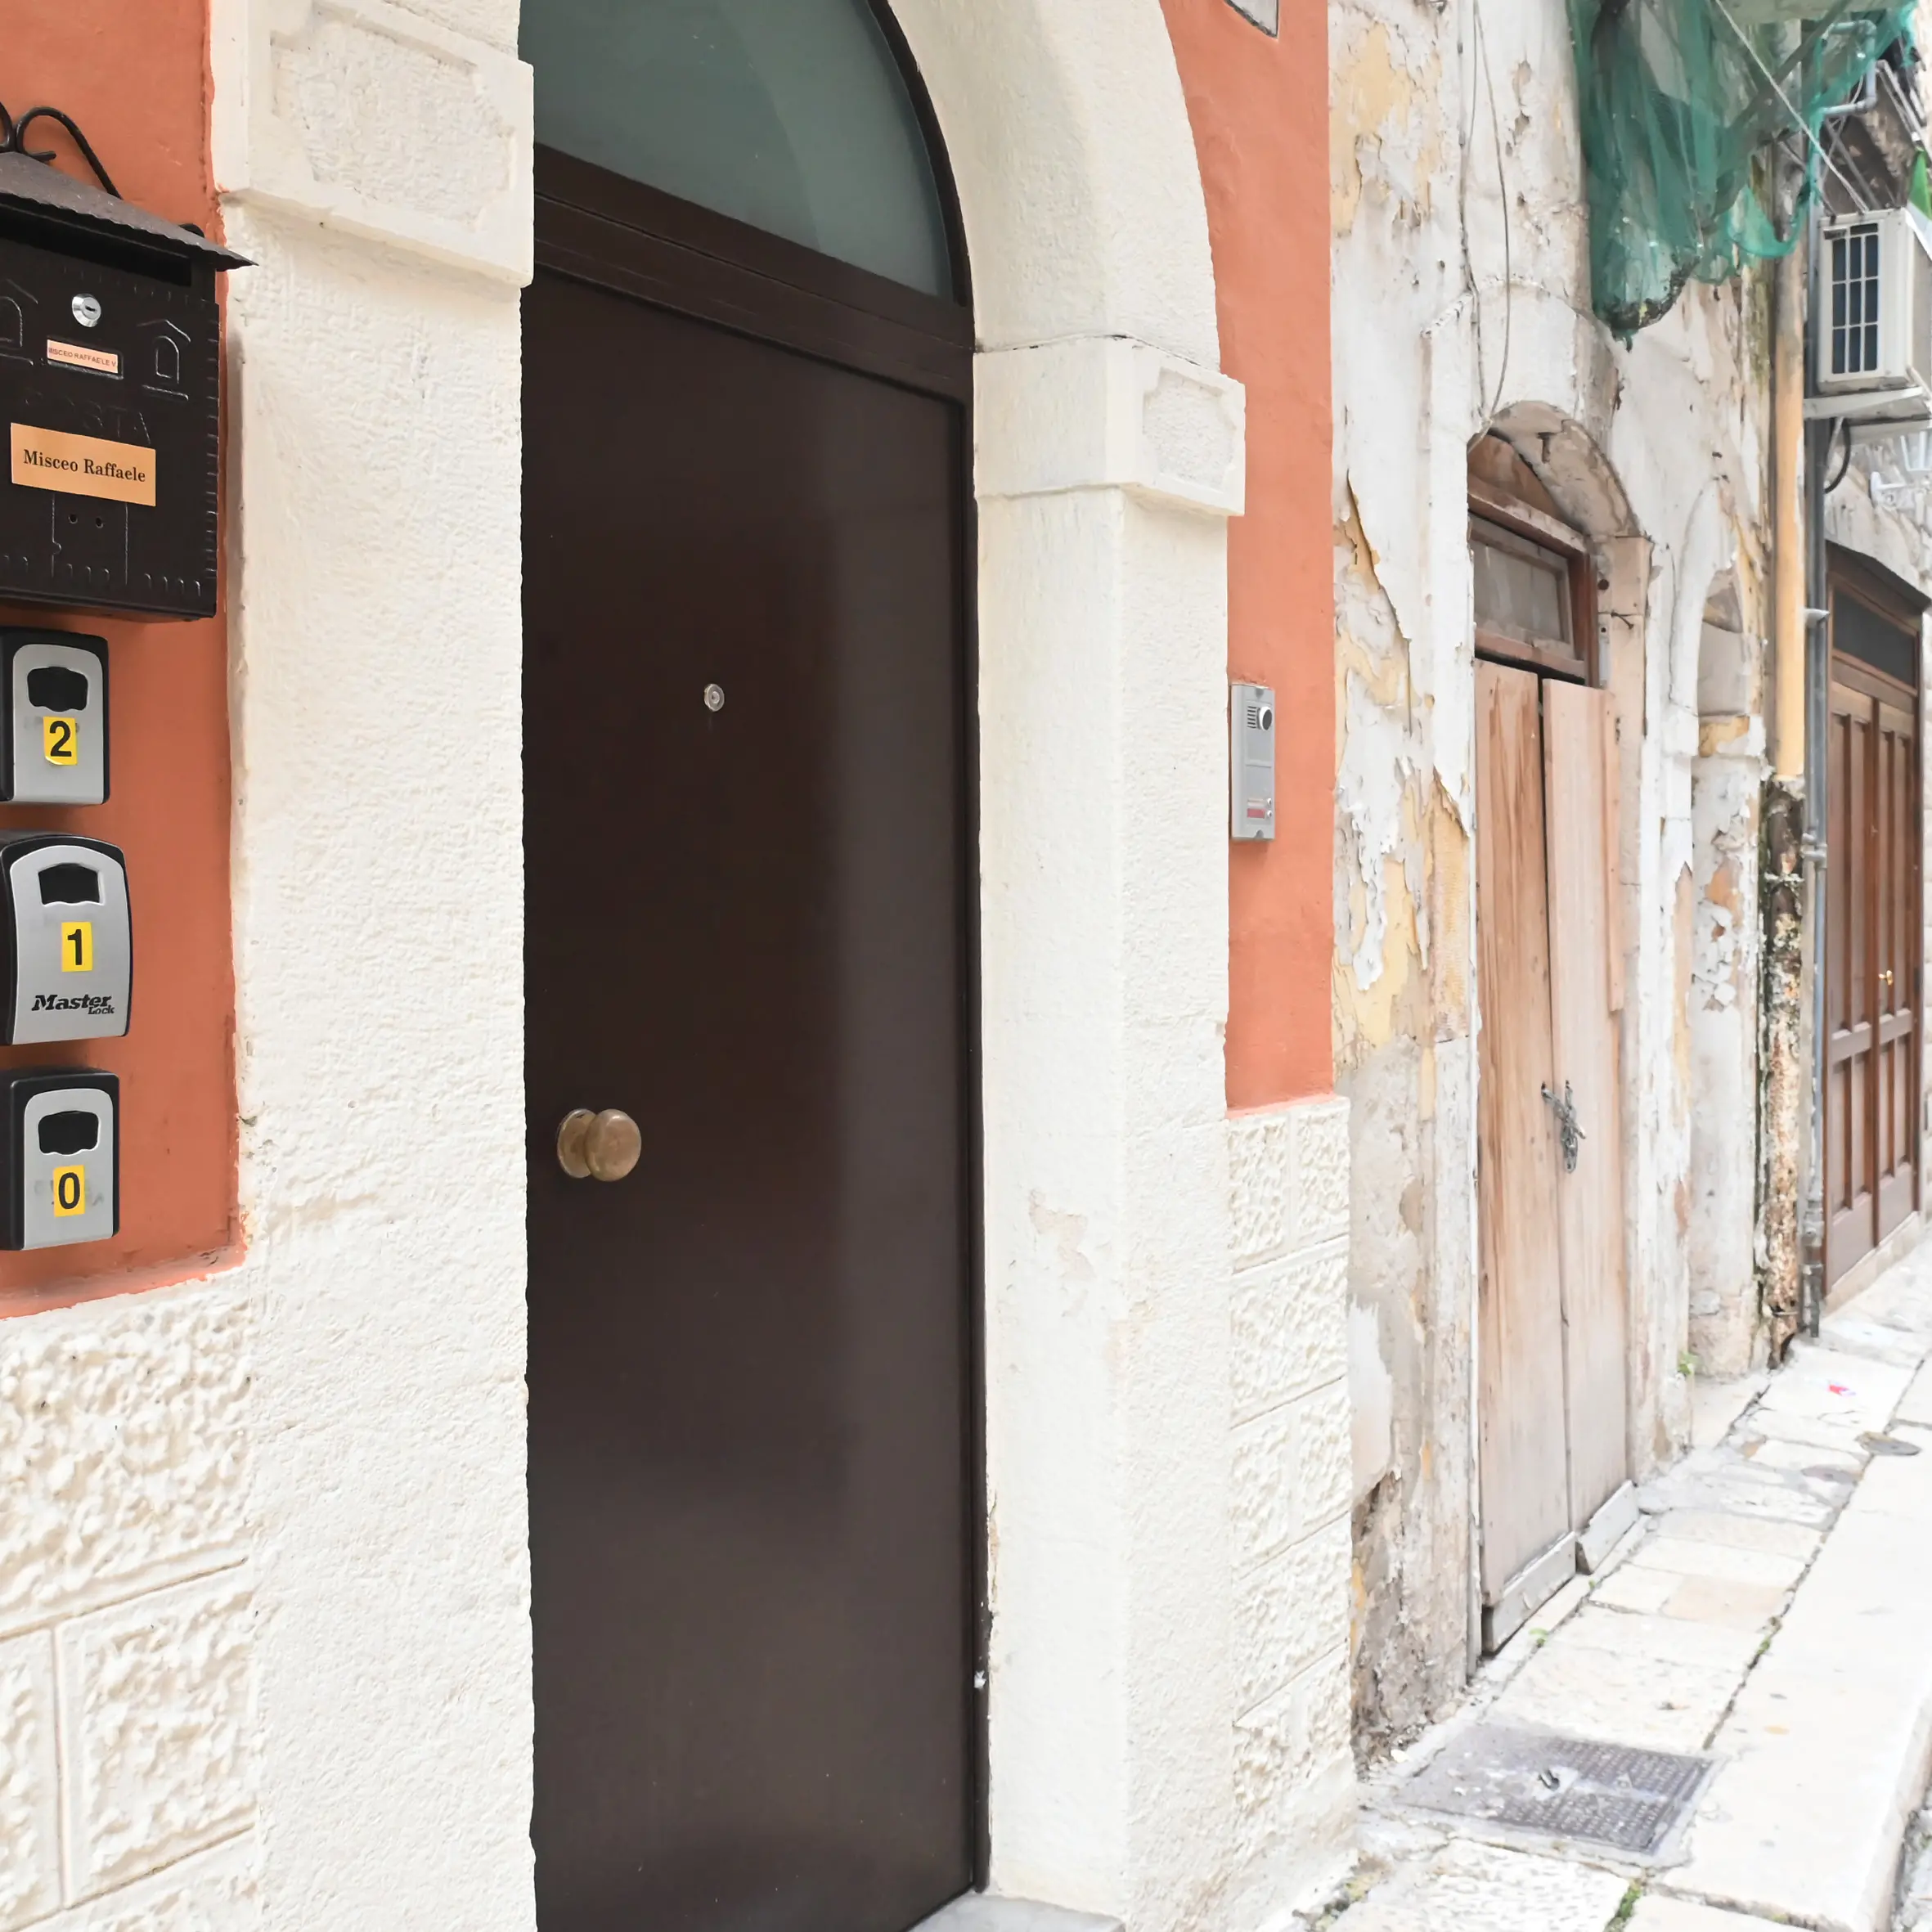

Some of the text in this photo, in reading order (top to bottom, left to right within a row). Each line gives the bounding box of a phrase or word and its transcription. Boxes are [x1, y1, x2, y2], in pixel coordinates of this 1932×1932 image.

[74, 353, 110, 366] RAFFAELE
[23, 449, 146, 482] Misceo Raffaele
[49, 720, 72, 757] 2
[67, 928, 83, 966] 1
[31, 994, 112, 1011] Master
[88, 1004, 115, 1015] Lock
[58, 1171, 80, 1210] 0
